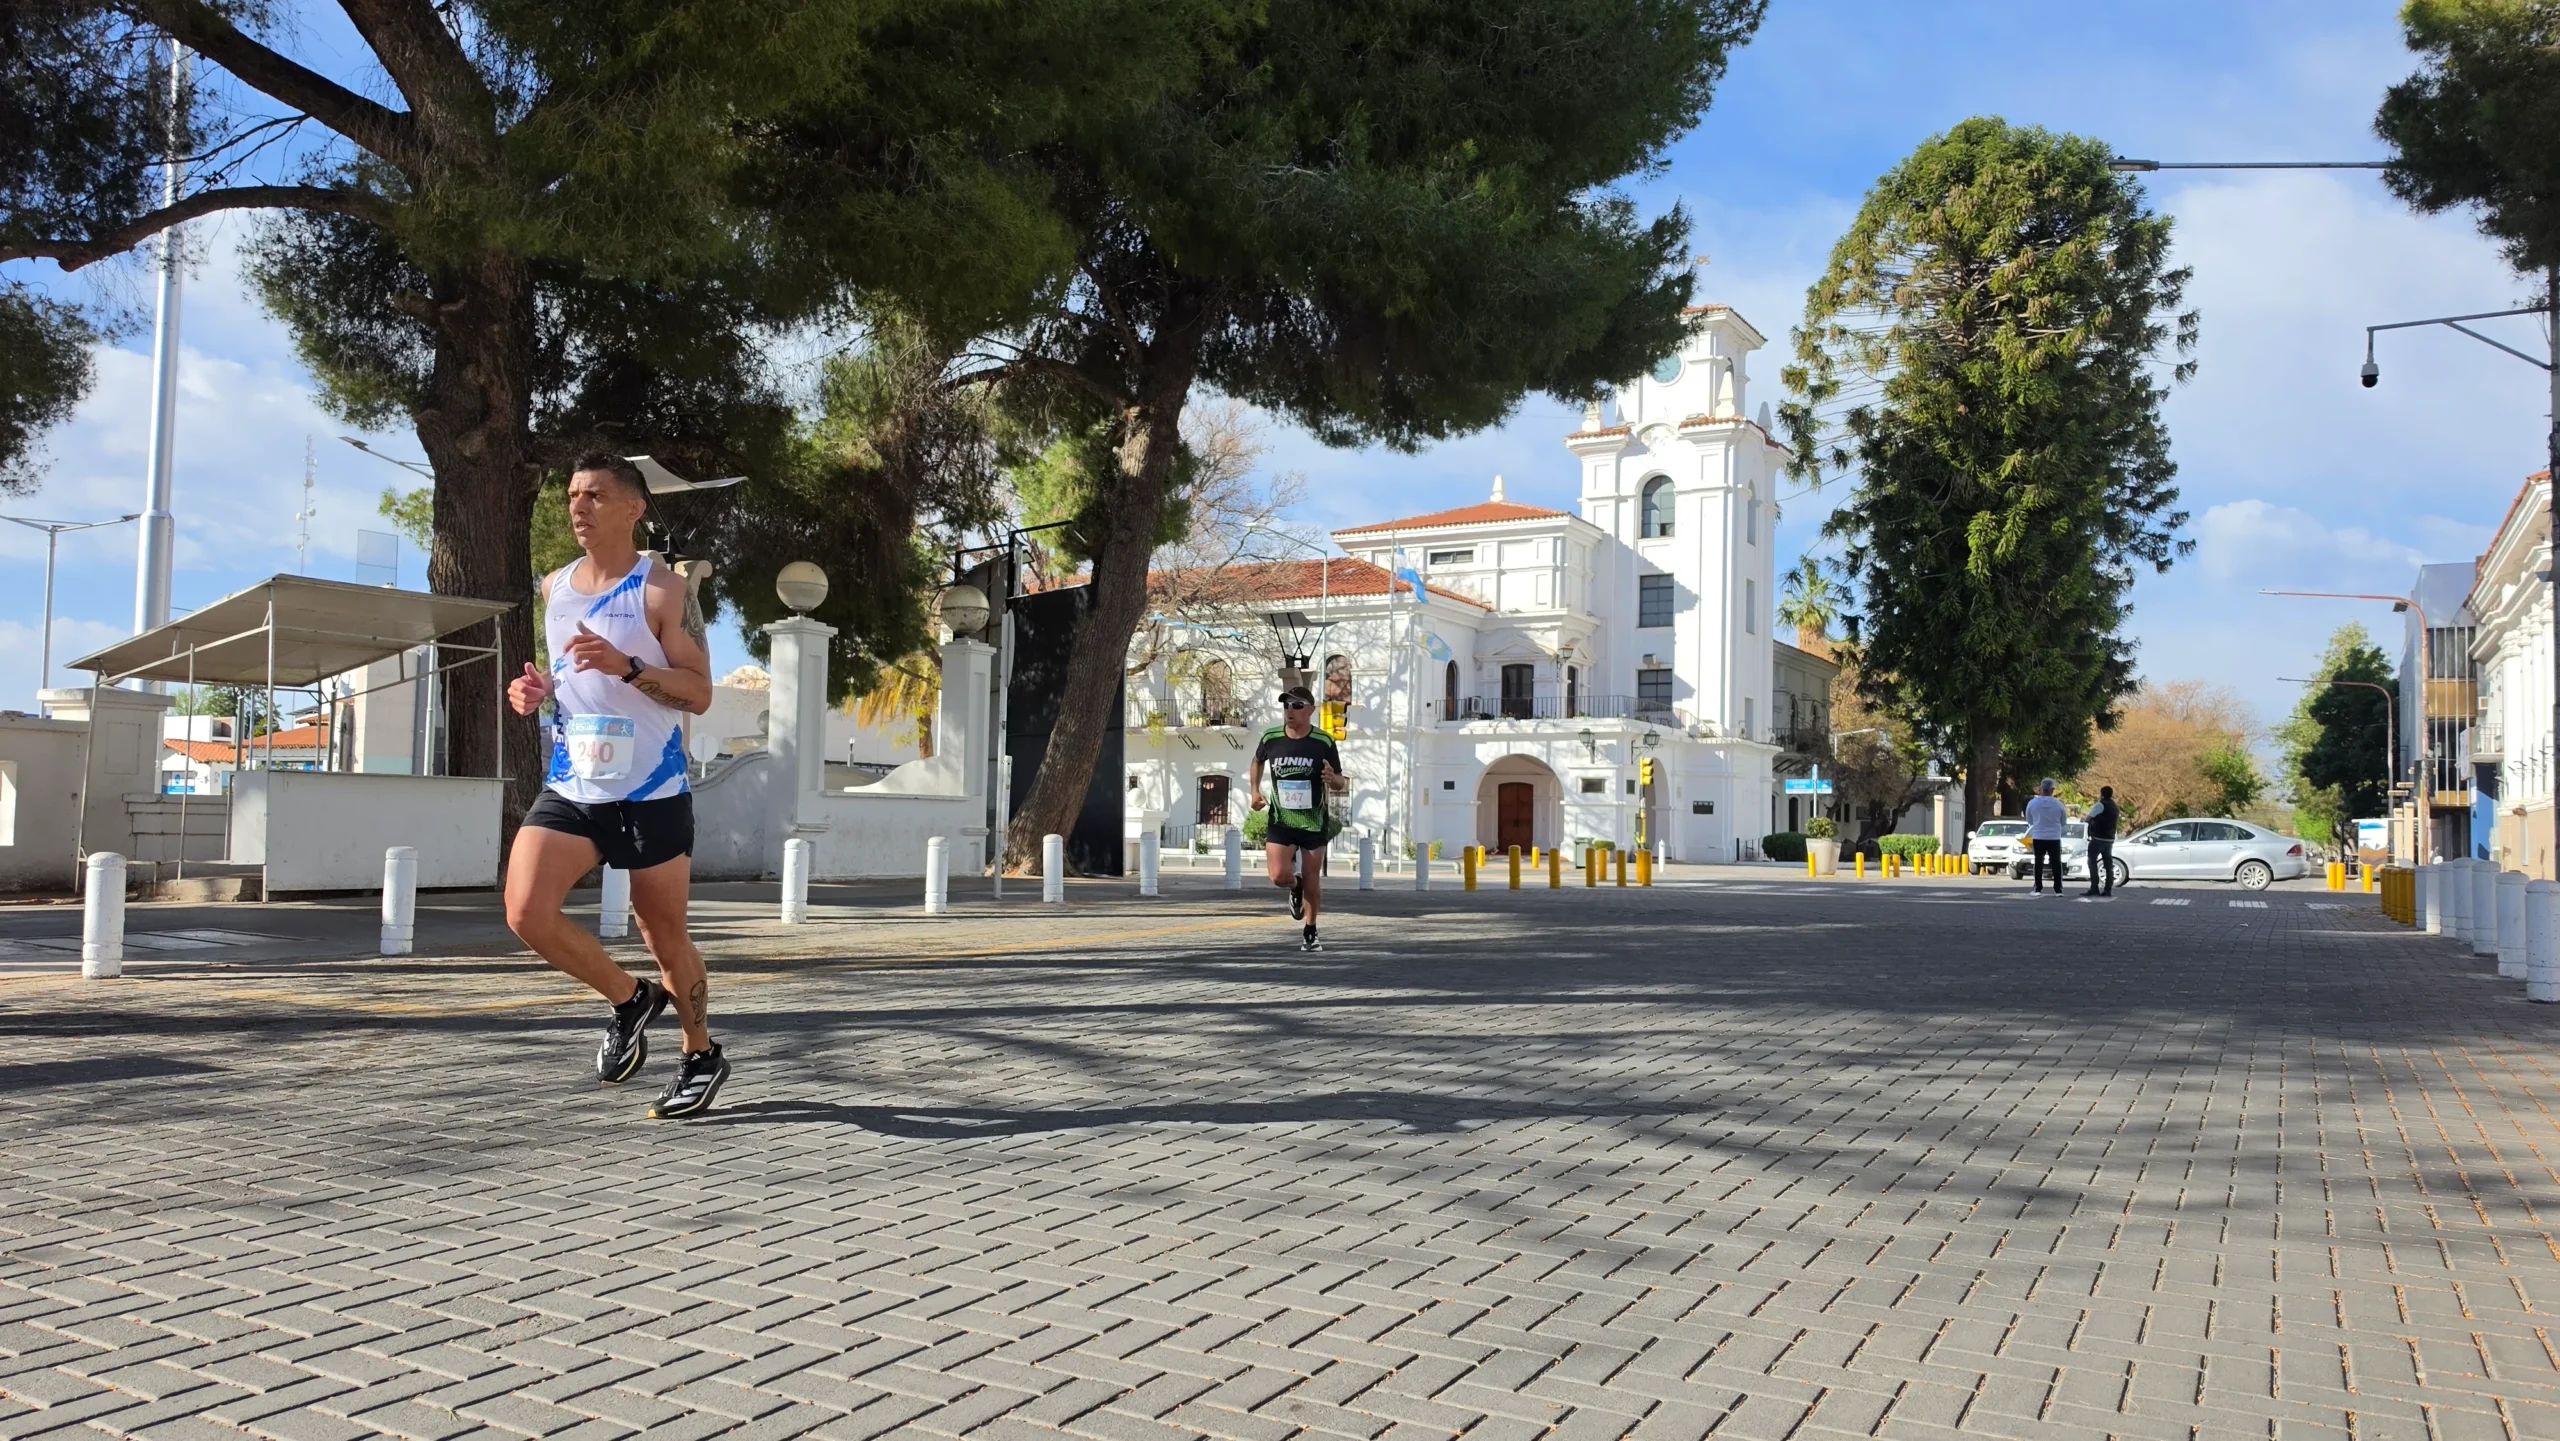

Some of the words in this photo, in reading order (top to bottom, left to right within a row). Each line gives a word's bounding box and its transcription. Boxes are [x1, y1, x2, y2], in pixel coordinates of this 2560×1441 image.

[577, 741, 614, 764] 240
[1271, 756, 1313, 767] JUNIN
[1273, 765, 1314, 777] Running
[1285, 792, 1304, 802] 247
